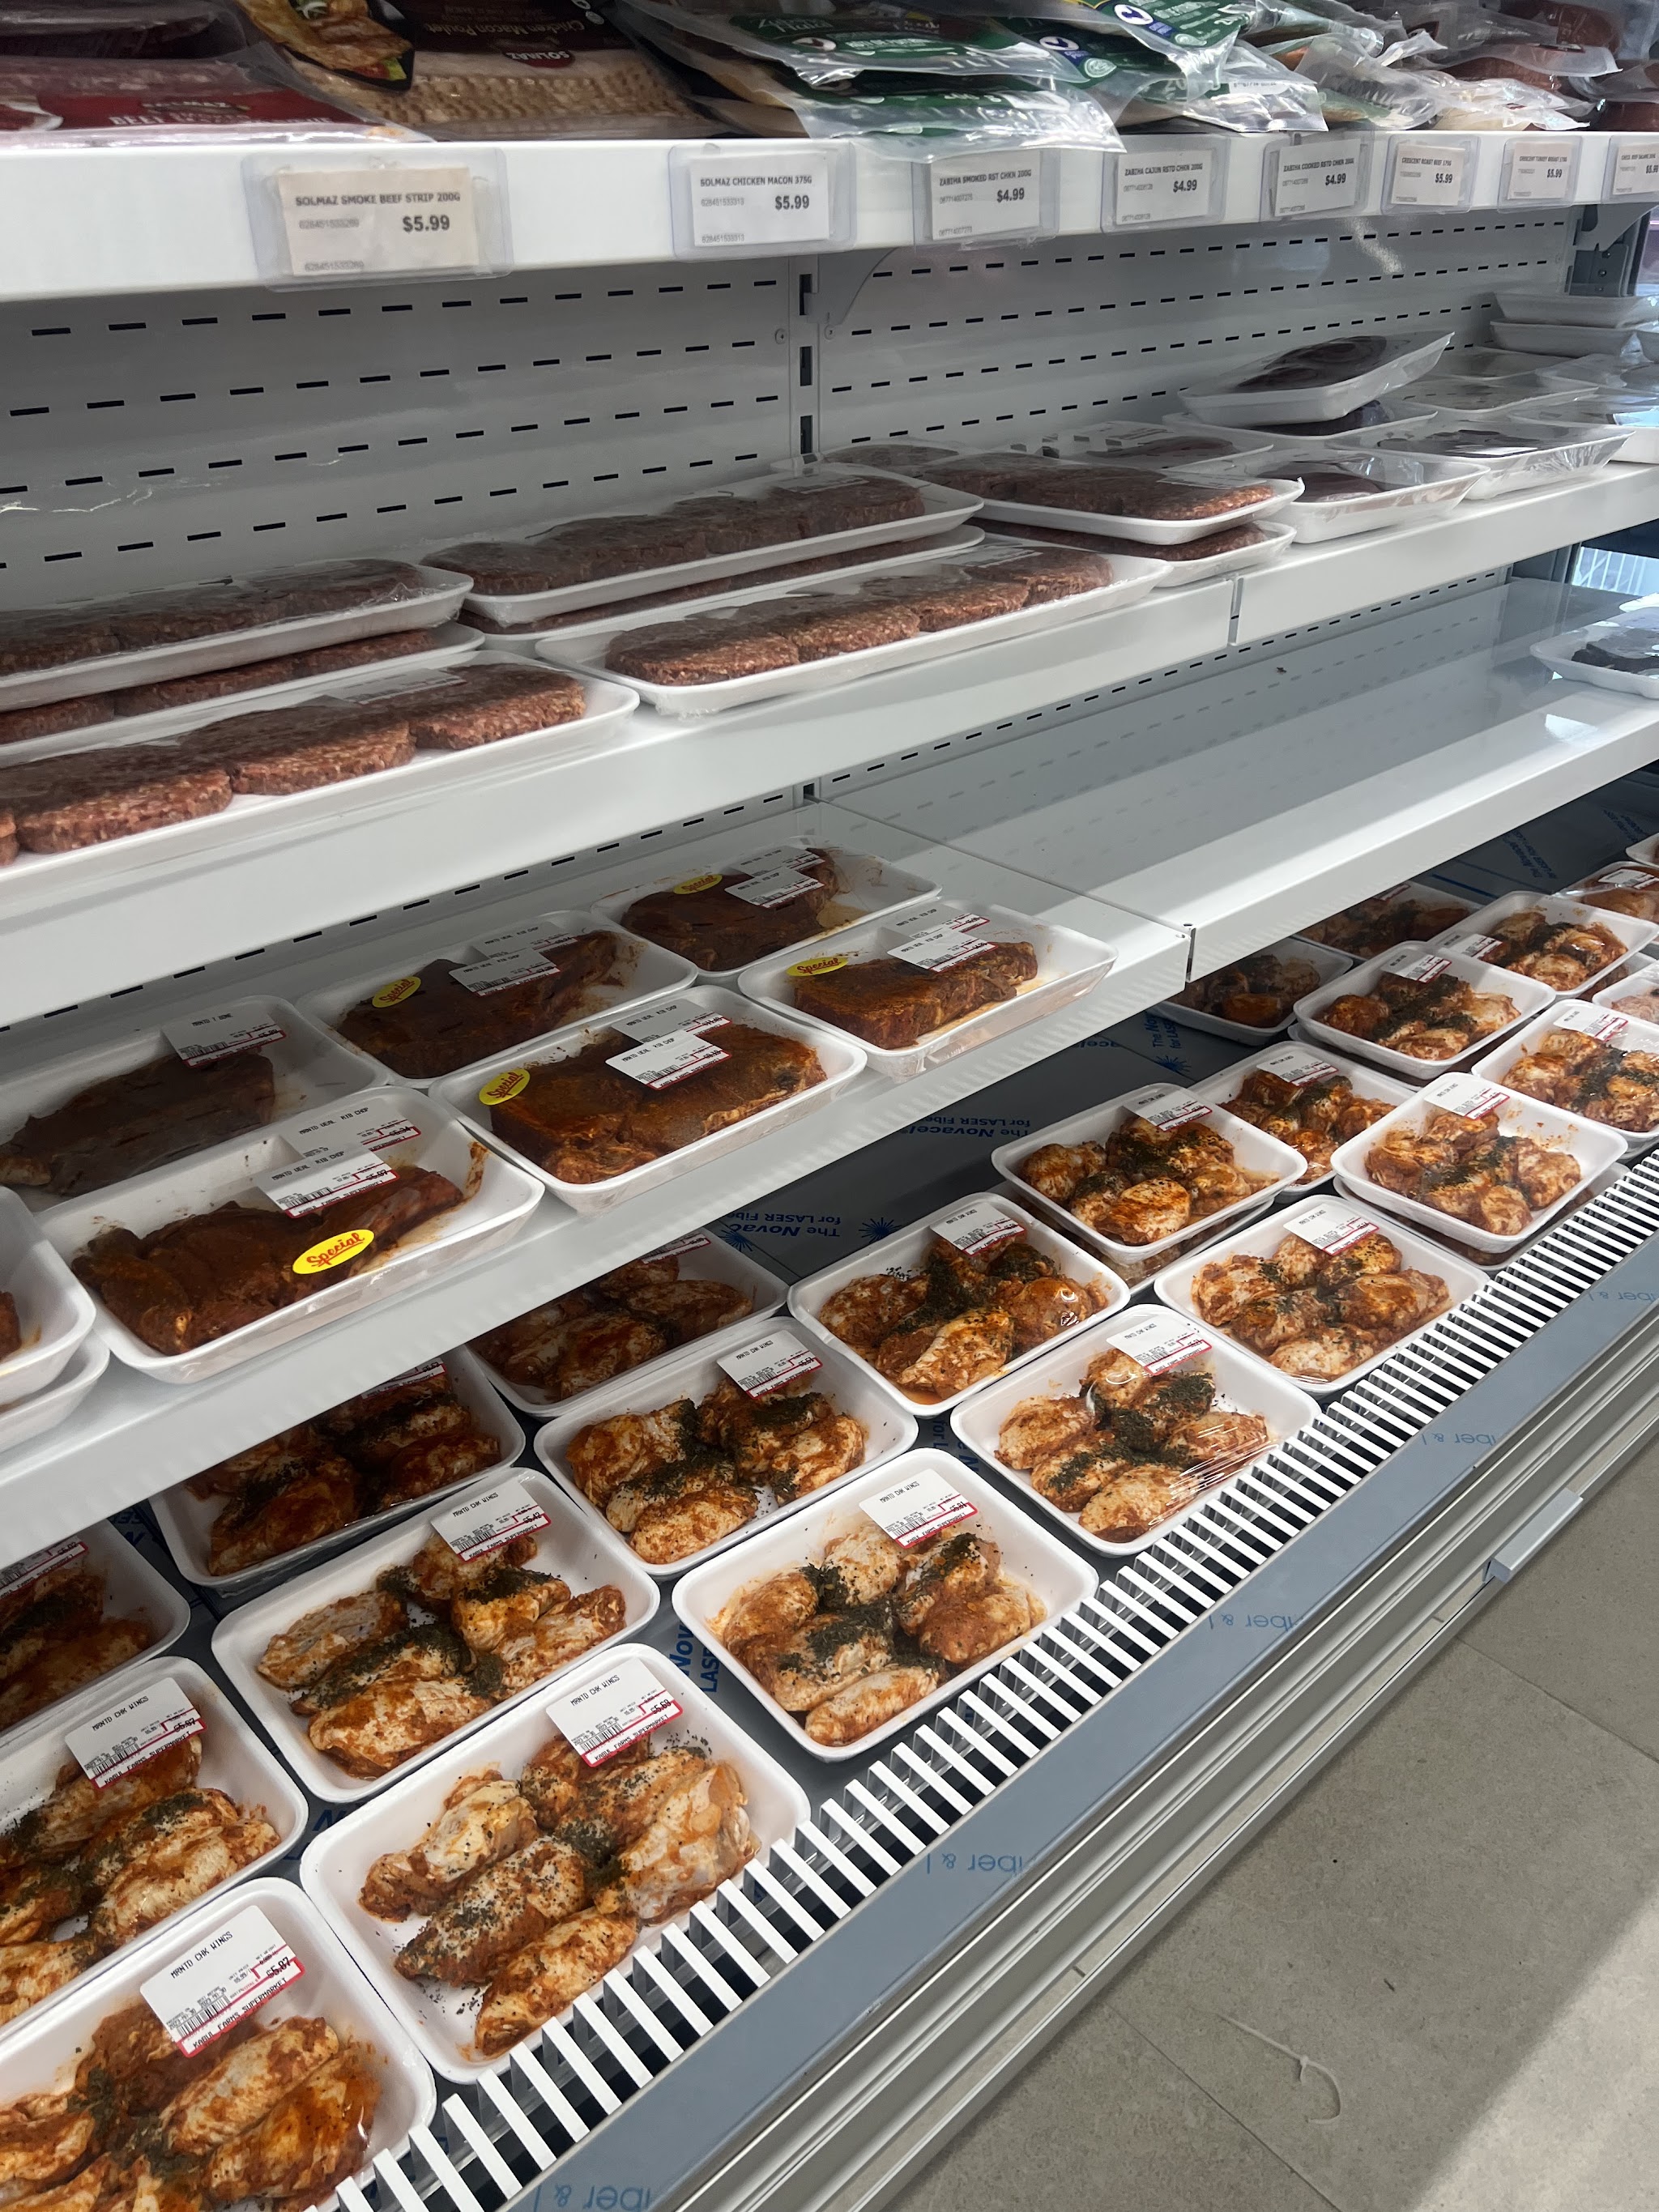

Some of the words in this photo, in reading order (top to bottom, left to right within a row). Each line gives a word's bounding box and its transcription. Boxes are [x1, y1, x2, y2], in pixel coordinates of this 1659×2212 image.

[506, 50, 570, 61] SOLMAZ
[940, 177, 961, 186] ZABIHA
[963, 174, 987, 183] SMOKED
[988, 173, 999, 181] RST
[1325, 173, 1346, 186] $4.99
[1435, 173, 1452, 184] $5.99
[1547, 168, 1562, 178] $5.99
[701, 177, 730, 187] SOLMAZ
[732, 177, 766, 186] CHICKEN
[768, 177, 792, 185] MACON
[795, 176, 812, 184] 375G
[1173, 180, 1197, 193] $4.99
[296, 195, 339, 206] SOLMAZ
[341, 194, 377, 204] SMOKE
[380, 194, 403, 203] BEEF
[406, 193, 434, 202] STRIP
[437, 192, 460, 202] 200G
[997, 188, 1024, 202] $4.99
[775, 195, 809, 211] $5.99
[403, 215, 450, 233] $5.99
[681, 876, 718, 891] Special
[797, 957, 842, 974] Special
[379, 979, 416, 1002] Special
[487, 1072, 525, 1099] Special
[340, 1113, 353, 1121] RIB
[354, 1107, 369, 1115] CHOP
[960, 1118, 1006, 1126] LASER
[315, 1157, 328, 1165] RIB
[330, 1151, 344, 1159] CHOP
[764, 1213, 814, 1224] LASER
[806, 1226, 840, 1237] The
[306, 1233, 365, 1267] Special
[1431, 1433, 1444, 1443] &
[482, 1492, 499, 1503] WINGS
[1221, 1613, 1234, 1626] &
[570, 1692, 590, 1707] MRNTD
[590, 1685, 602, 1696] CHK
[602, 1675, 621, 1688] WINGS
[92, 1716, 113, 1731] MRNTD
[114, 1707, 127, 1718] CHK
[129, 1695, 149, 1710] WINGS
[633, 1714, 669, 1737] SUPERMARKET
[940, 1853, 957, 1871] &
[170, 1959, 194, 1979] MRNTD
[194, 1948, 210, 1962] CHK
[211, 1931, 233, 1950] WINGS
[266, 1956, 292, 1978] $5.87
[217, 2011, 241, 2031] FARMS
[241, 1977, 288, 2014] SUPERMARKET
[553, 2184, 572, 2208] &
